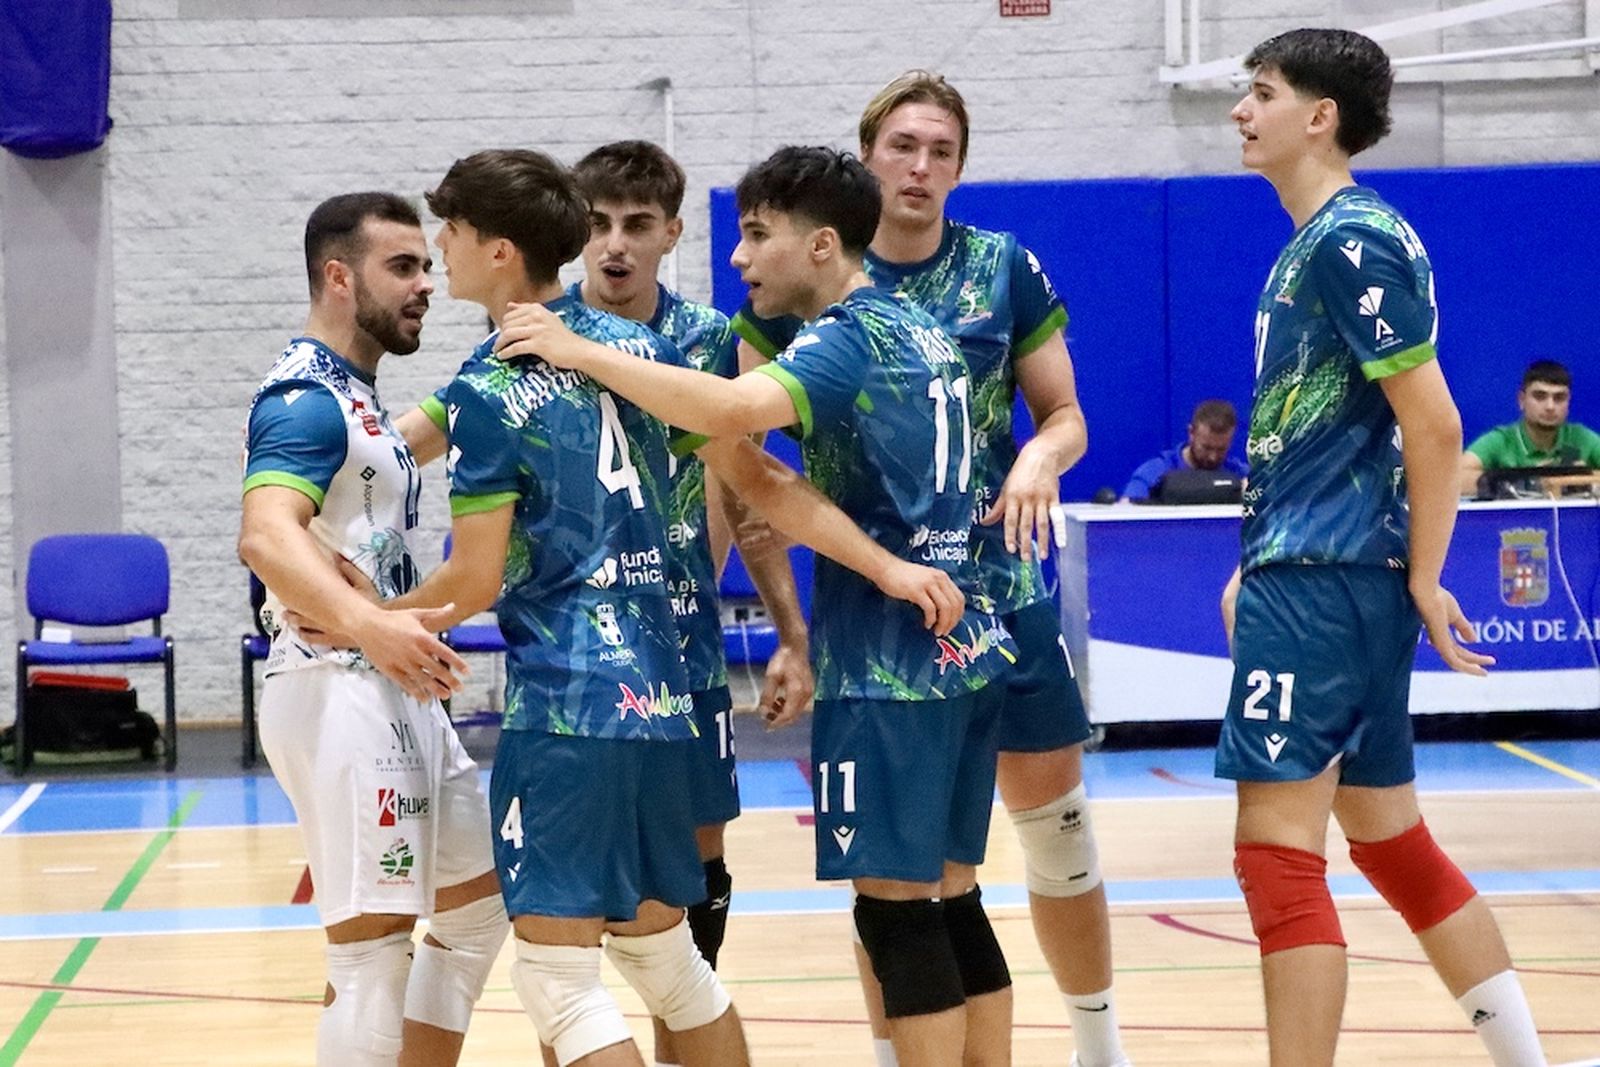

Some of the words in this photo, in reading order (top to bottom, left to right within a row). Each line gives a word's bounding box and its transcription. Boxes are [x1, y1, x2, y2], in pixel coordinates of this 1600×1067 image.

[1014, 6, 1049, 15] ALARMA
[597, 391, 645, 510] 4
[928, 376, 971, 494] 11
[1532, 619, 1568, 643] DE
[1243, 669, 1296, 723] 21
[818, 760, 857, 814] 11
[500, 796, 524, 849] 4
